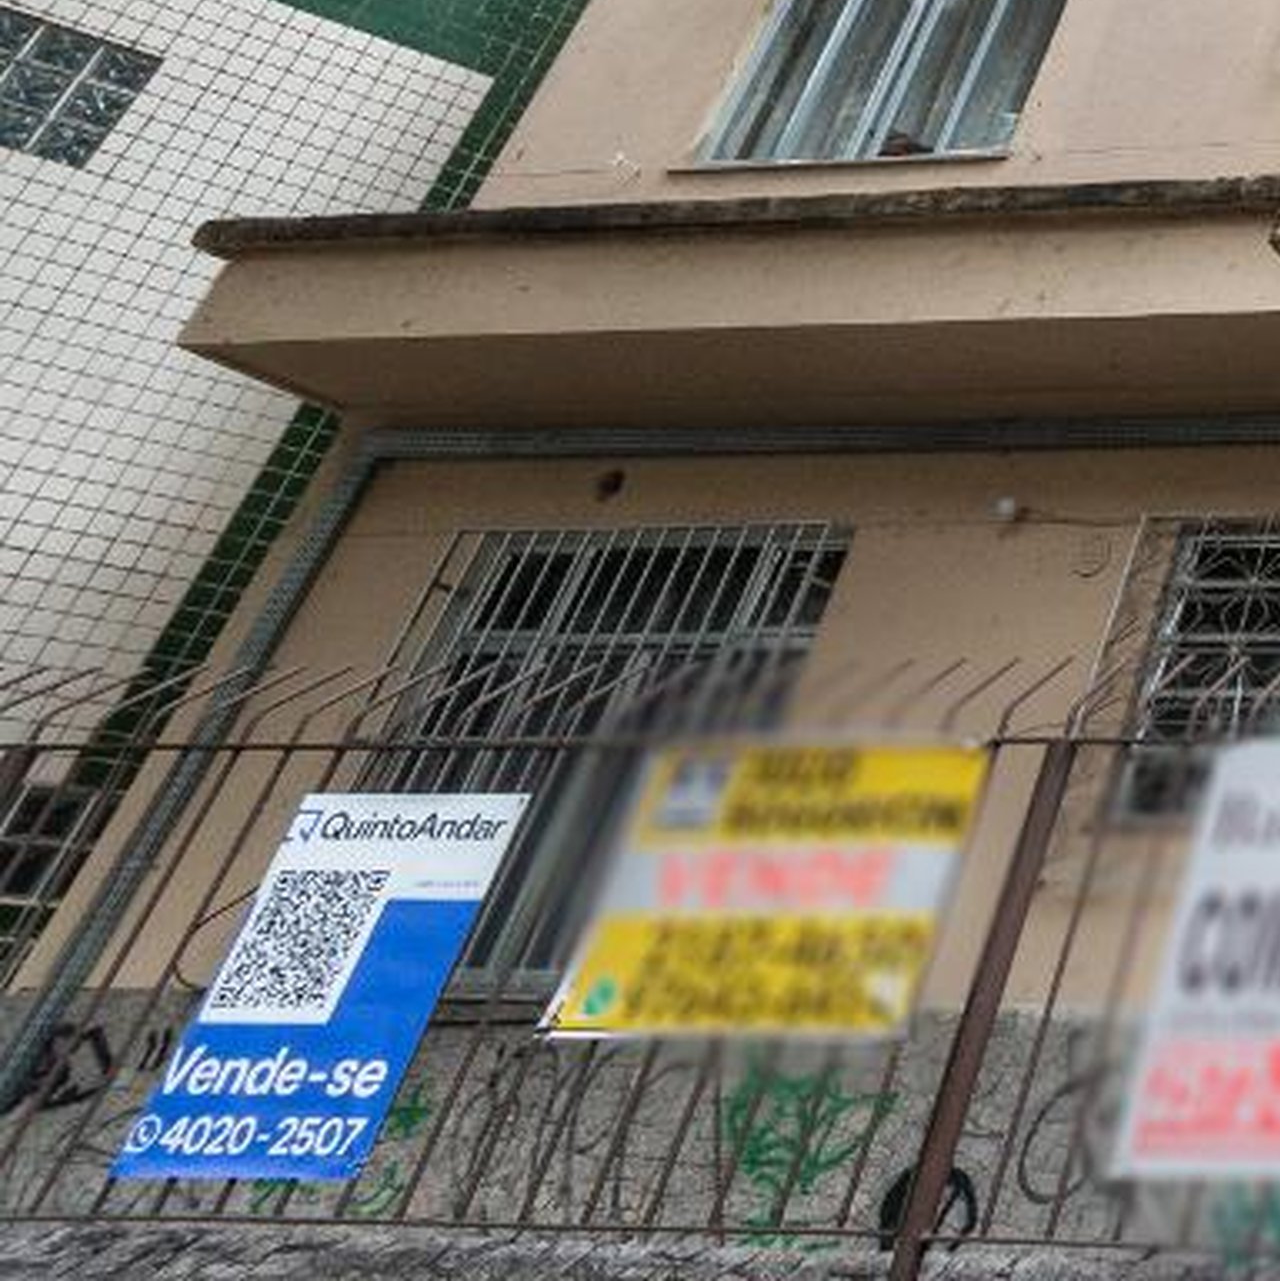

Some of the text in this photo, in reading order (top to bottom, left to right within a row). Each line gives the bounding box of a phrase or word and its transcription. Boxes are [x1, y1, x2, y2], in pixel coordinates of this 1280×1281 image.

[320, 812, 507, 842] QuintoAndar
[161, 1044, 388, 1098] Vende-se
[158, 1115, 369, 1157] 4020-2507
